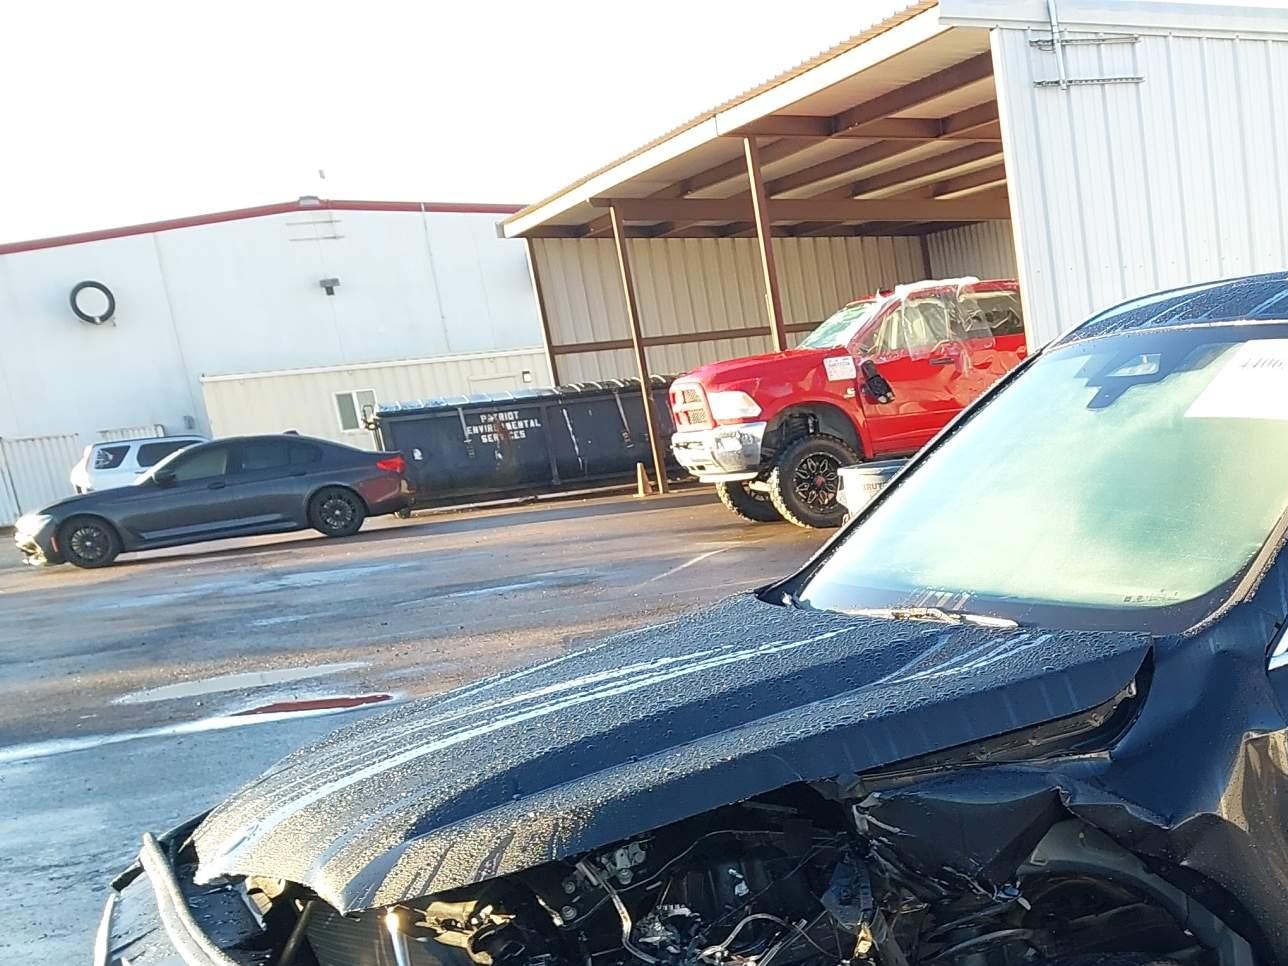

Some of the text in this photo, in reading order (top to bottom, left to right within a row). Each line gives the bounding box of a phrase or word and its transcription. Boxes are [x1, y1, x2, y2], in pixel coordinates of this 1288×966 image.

[480, 410, 520, 423] PATRIOT
[466, 418, 542, 435] ENVIRMENTAL
[480, 429, 527, 443] SERES
